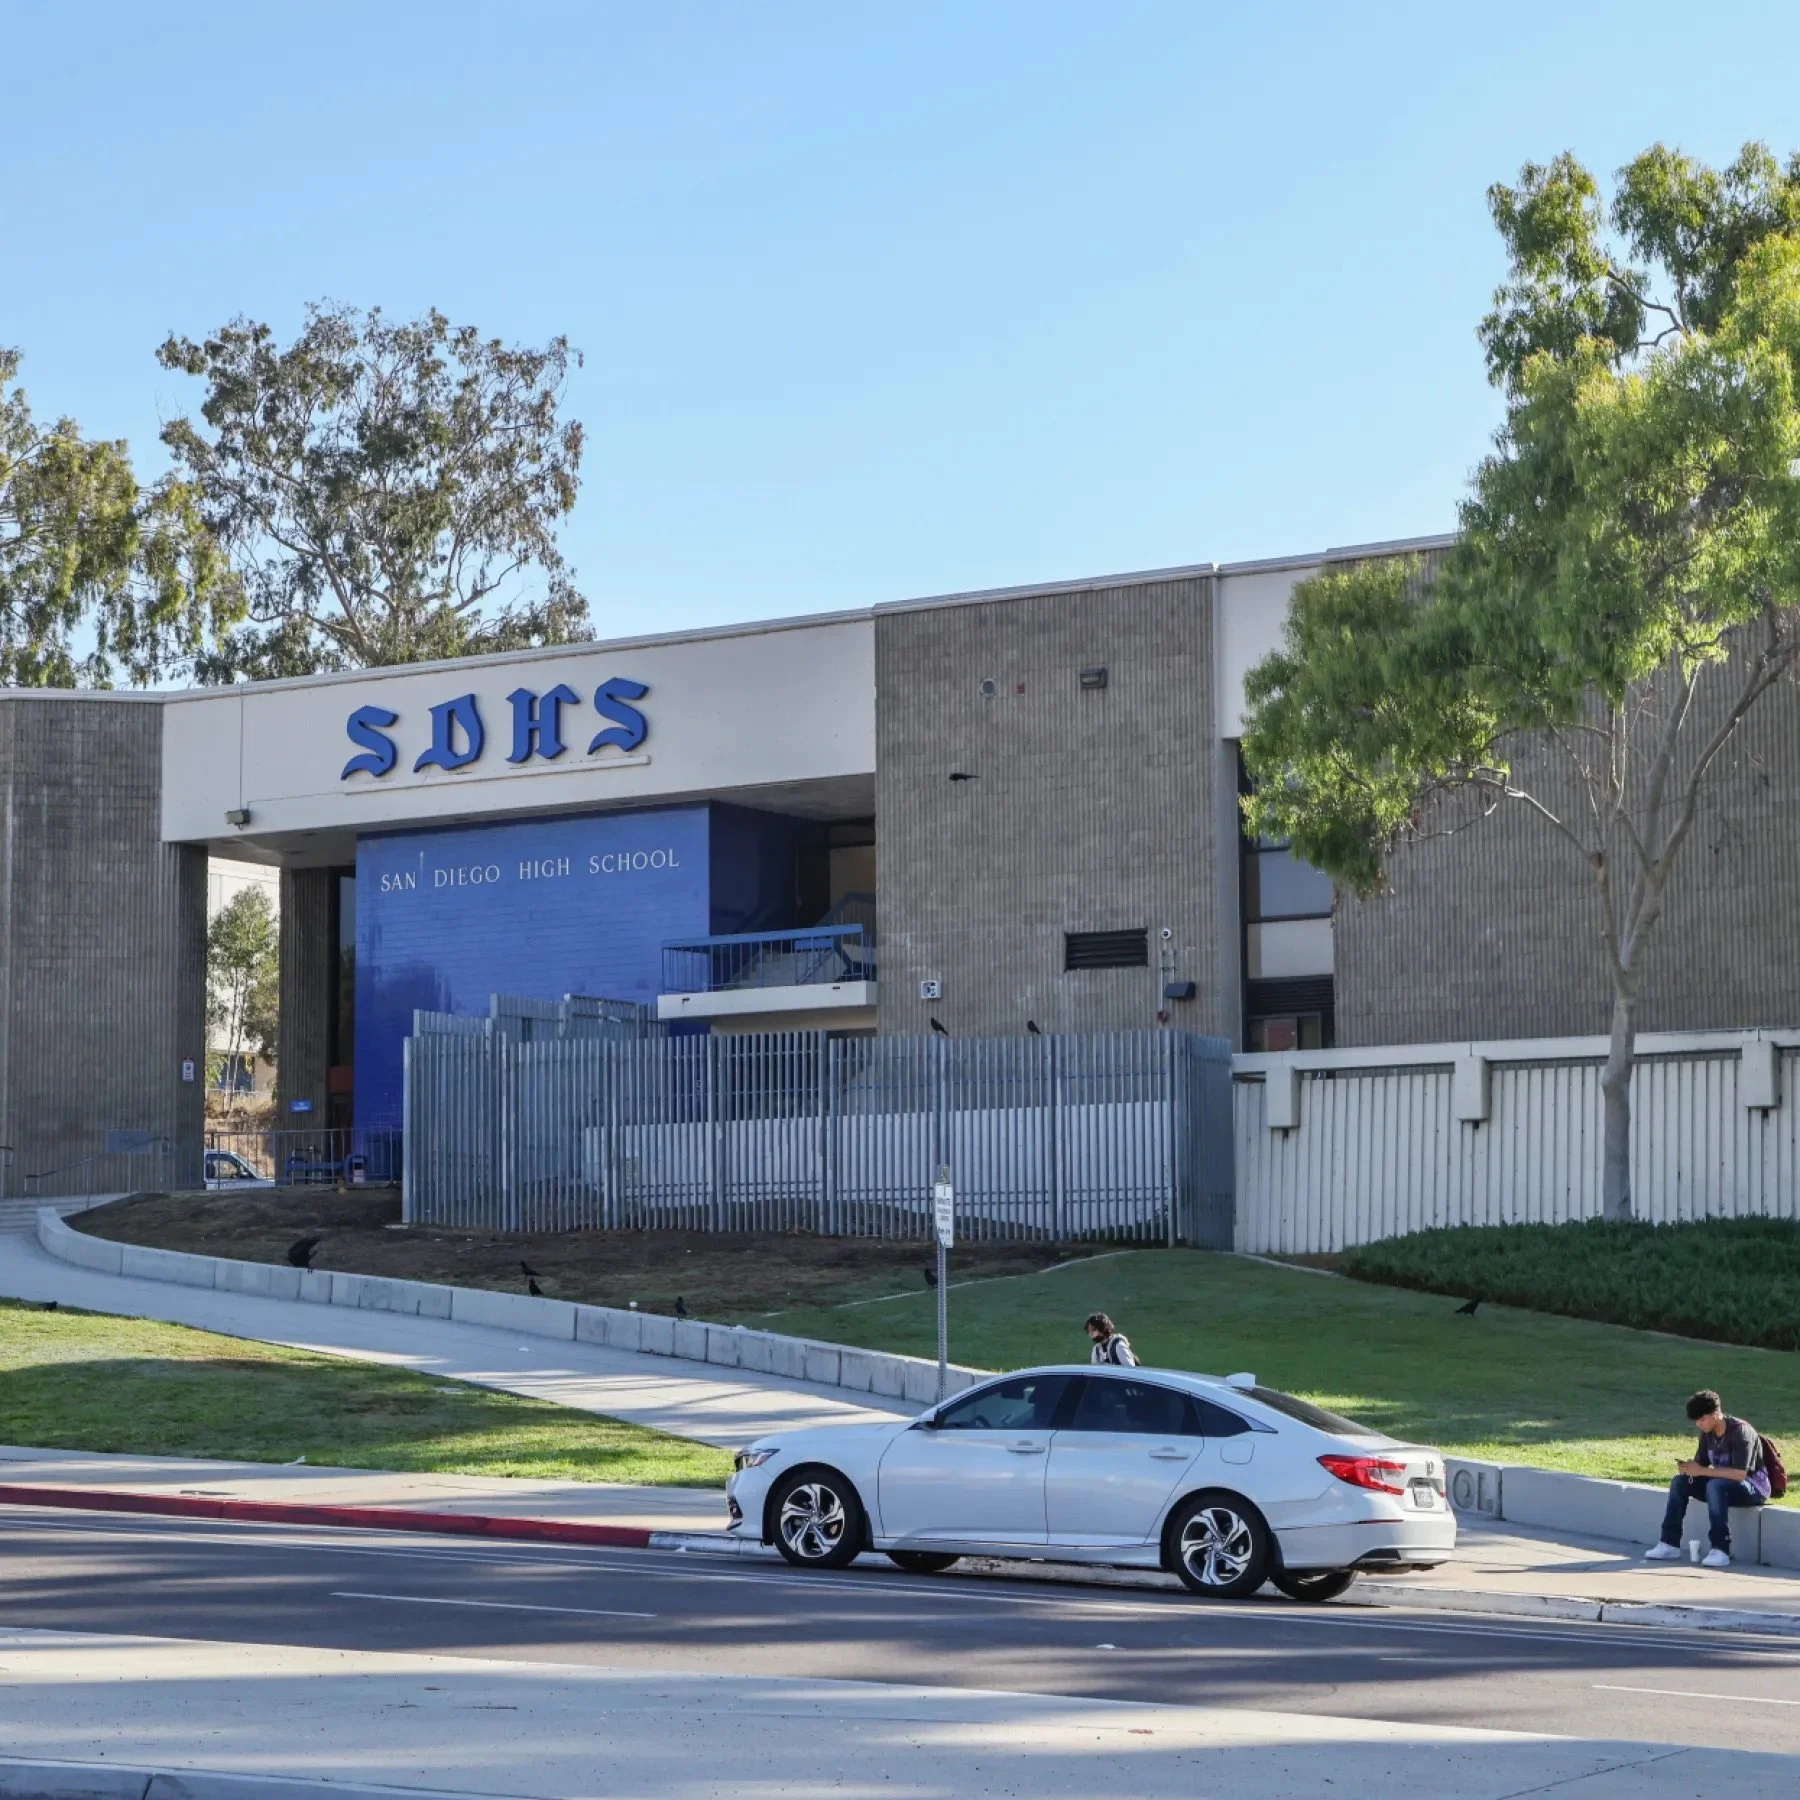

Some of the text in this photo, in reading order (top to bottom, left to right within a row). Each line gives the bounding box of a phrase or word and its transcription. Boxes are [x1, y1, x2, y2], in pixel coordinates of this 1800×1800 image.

[341, 677, 650, 780] SDHS
[380, 848, 681, 893] SAN DIEGO HIGH SCHOOL
